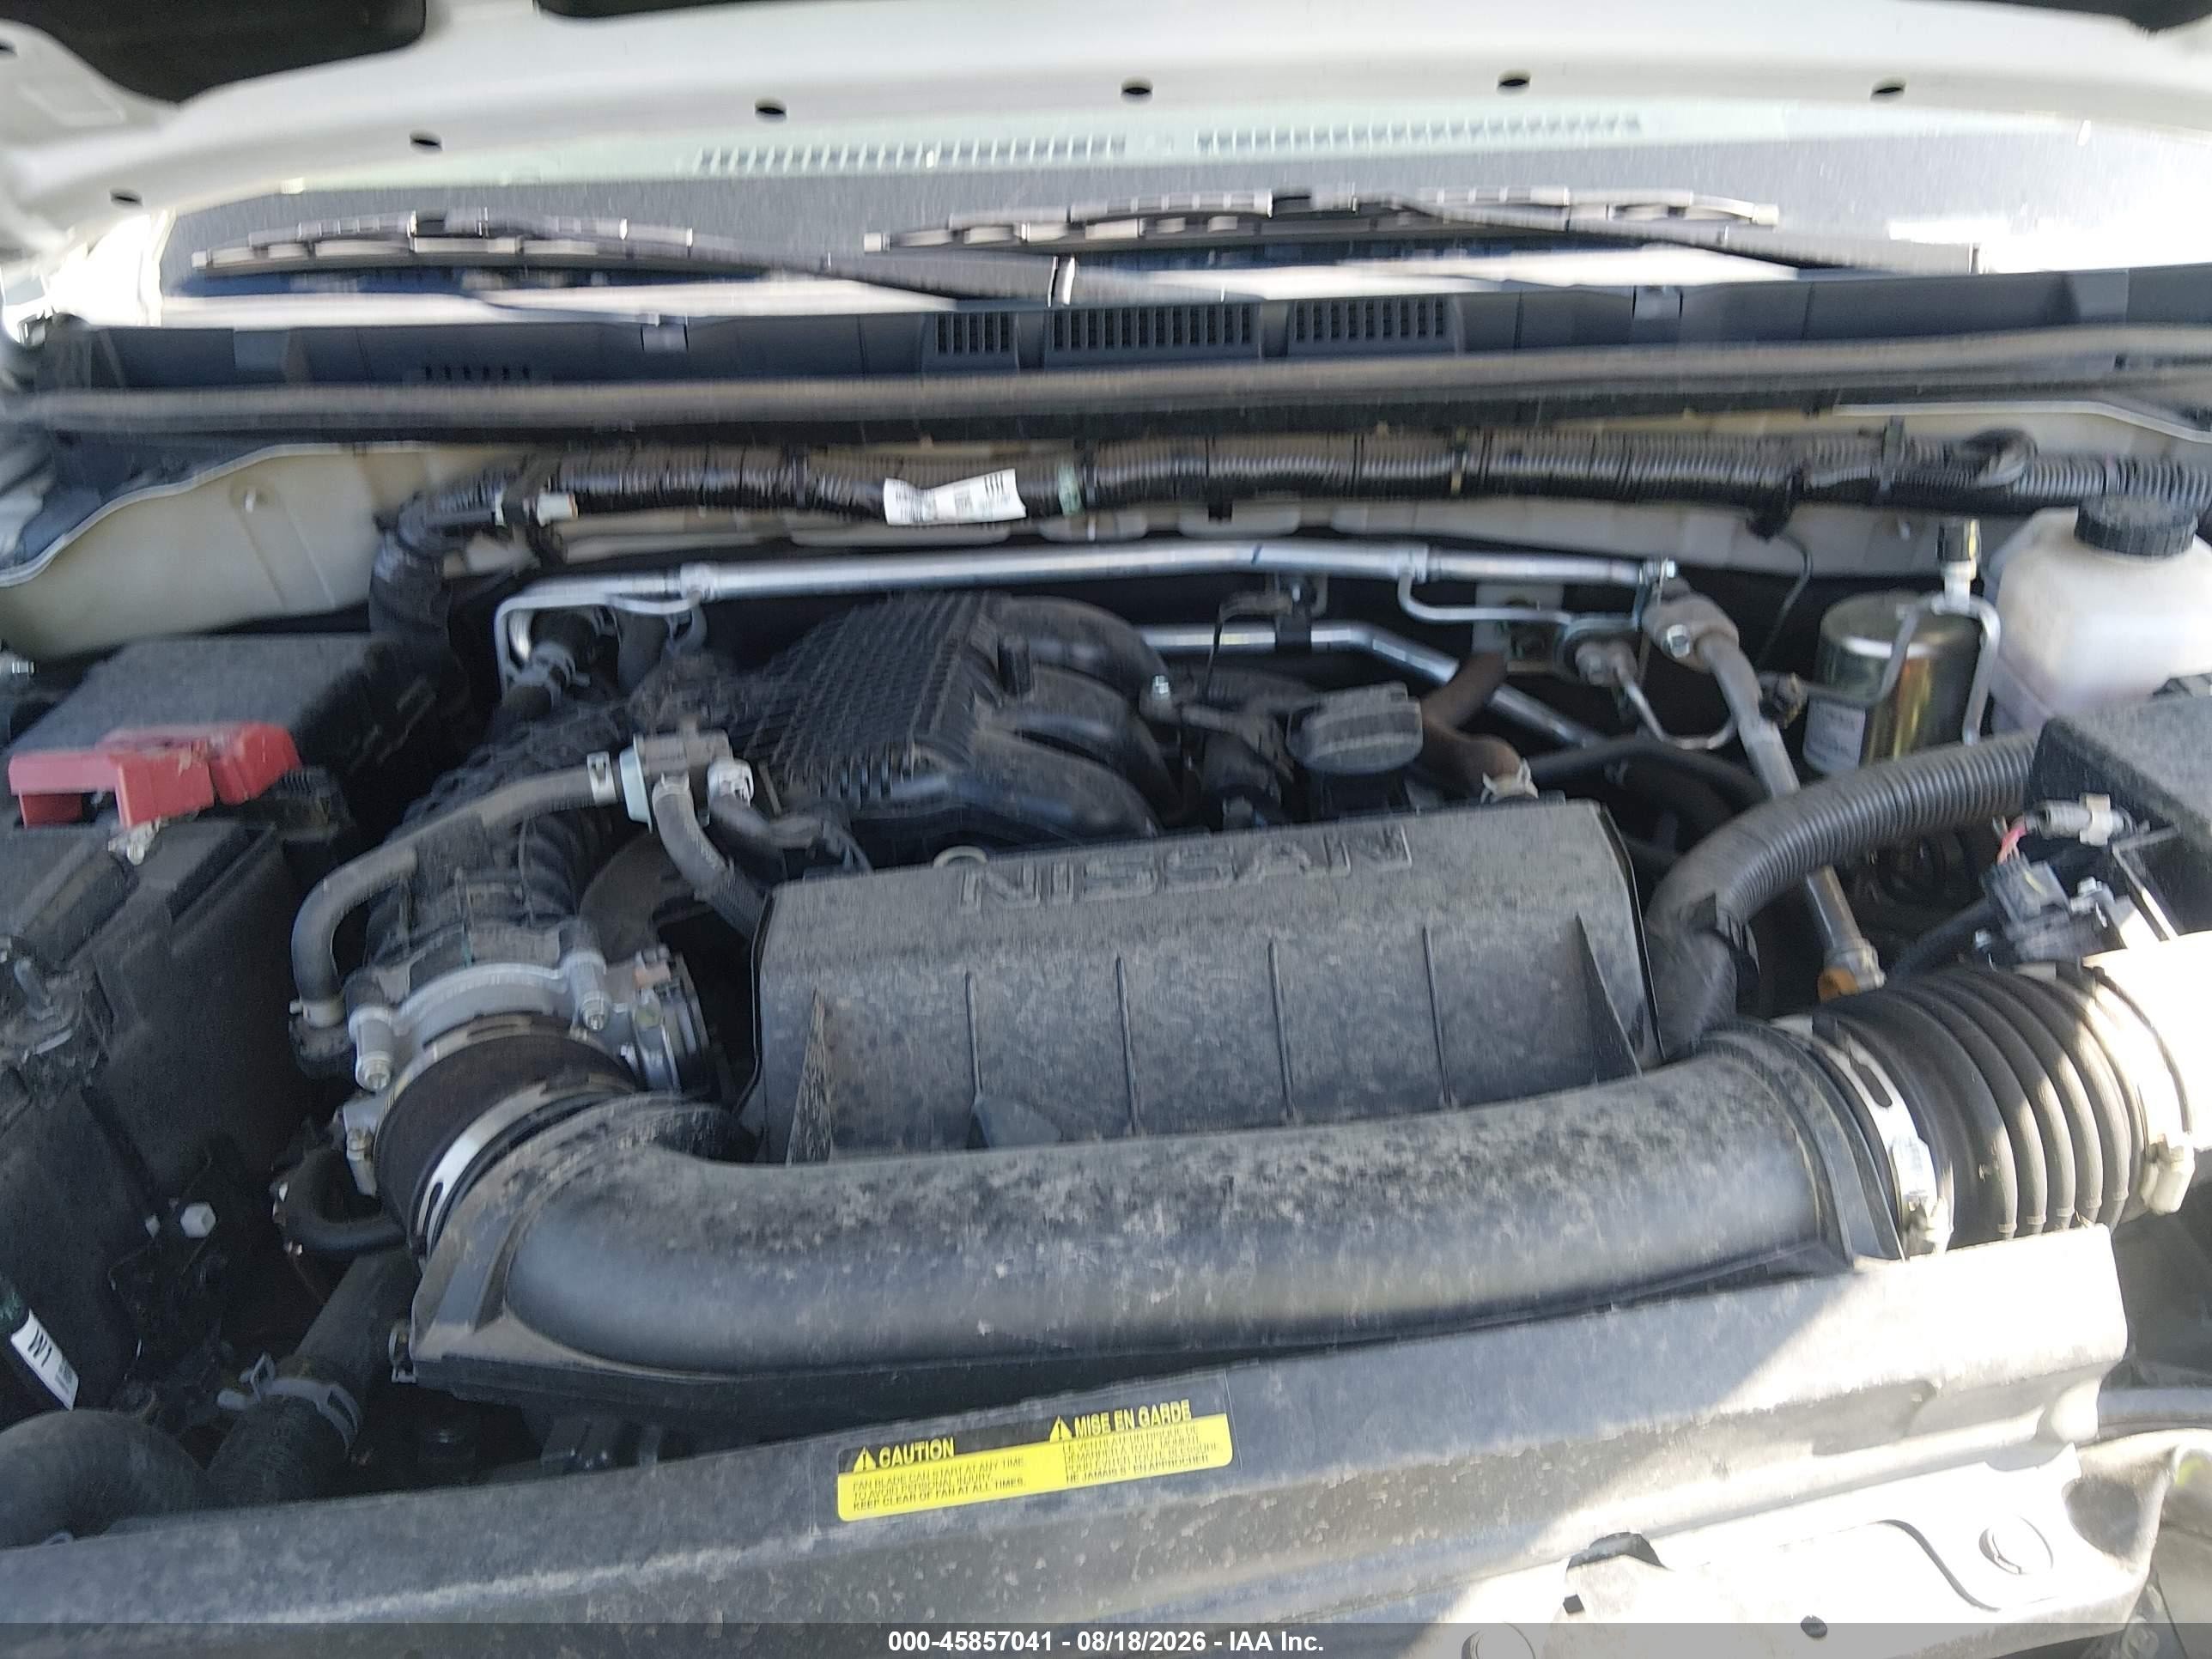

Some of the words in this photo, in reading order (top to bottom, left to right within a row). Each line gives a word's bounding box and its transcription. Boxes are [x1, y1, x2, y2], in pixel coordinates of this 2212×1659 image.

[958, 824, 1412, 912] NISSAN
[1074, 1411, 1111, 1438] MISE
[1114, 1408, 1135, 1432] EN
[1138, 1398, 1192, 1429] GARDE
[878, 1437, 955, 1468] CAUTION
[854, 1498, 880, 1511] KEEP
[883, 1493, 916, 1507] CLEAR
[919, 1491, 933, 1501] OF
[935, 1487, 954, 1498] FAN
[957, 1485, 969, 1495] AT
[971, 1482, 990, 1493] ALL
